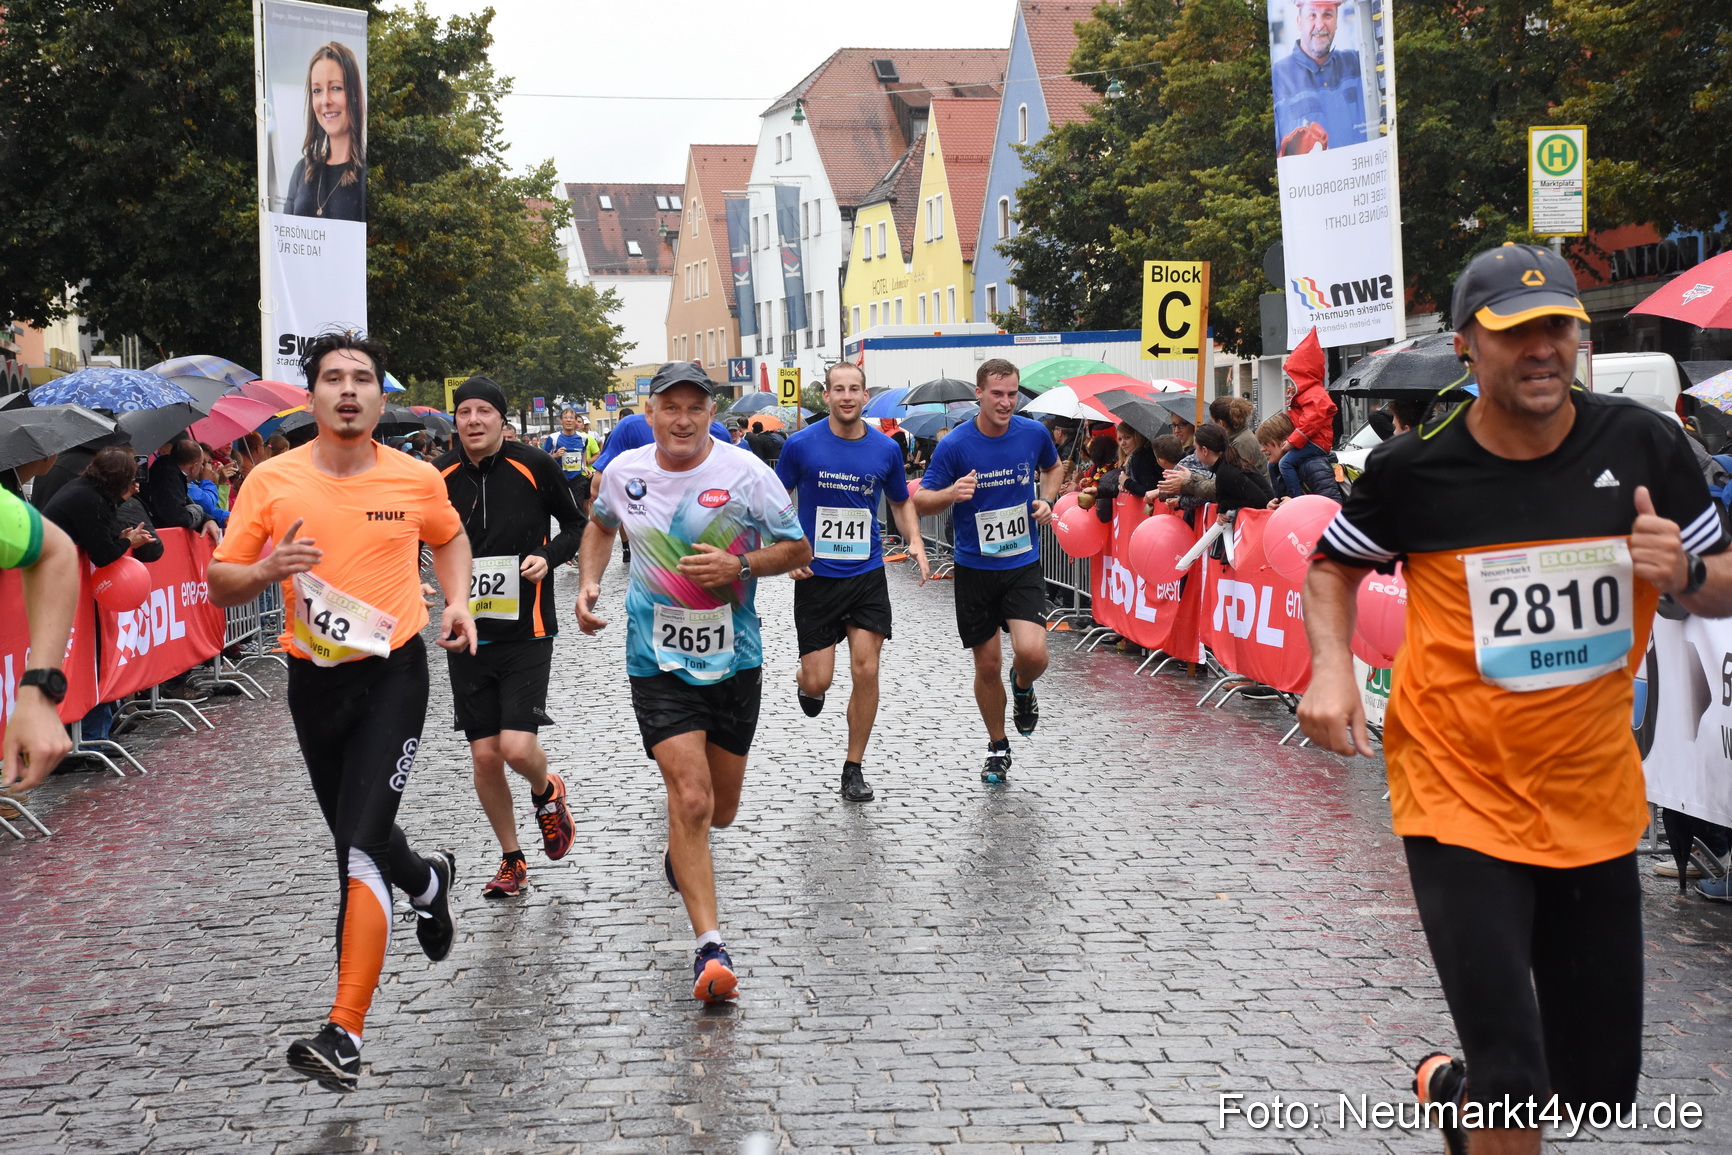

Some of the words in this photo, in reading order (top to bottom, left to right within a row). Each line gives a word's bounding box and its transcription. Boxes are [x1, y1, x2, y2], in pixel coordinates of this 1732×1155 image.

[1540, 180, 1575, 189] Marktplatz
[277, 240, 291, 254] ÜR
[292, 243, 305, 256] SIE
[306, 245, 322, 257] DA!
[1151, 265, 1202, 283] Block
[872, 278, 889, 296] HOTEL
[1158, 290, 1192, 340] C
[780, 369, 799, 377] Block
[783, 378, 795, 398] D
[818, 471, 860, 482] Kirwaläufer
[976, 478, 1016, 489] ettenhofen
[817, 481, 860, 492] Pettenhofen
[366, 511, 406, 521] THULE
[841, 509, 868, 517] BOCK
[821, 519, 865, 540] 2141
[983, 516, 1026, 542] 2140
[833, 543, 853, 552] Michi
[997, 542, 1018, 553] Jakob
[479, 558, 513, 569] BOCK
[1539, 545, 1617, 569] BOCK
[1480, 565, 1531, 578] NeuerMarkt
[326, 590, 371, 620] BOCK
[475, 601, 493, 611] Olaf
[1489, 575, 1620, 638] 2810
[303, 597, 351, 642] 143
[661, 623, 726, 654] 2651
[683, 656, 706, 669] Toni
[1529, 644, 1589, 670] Bernd
